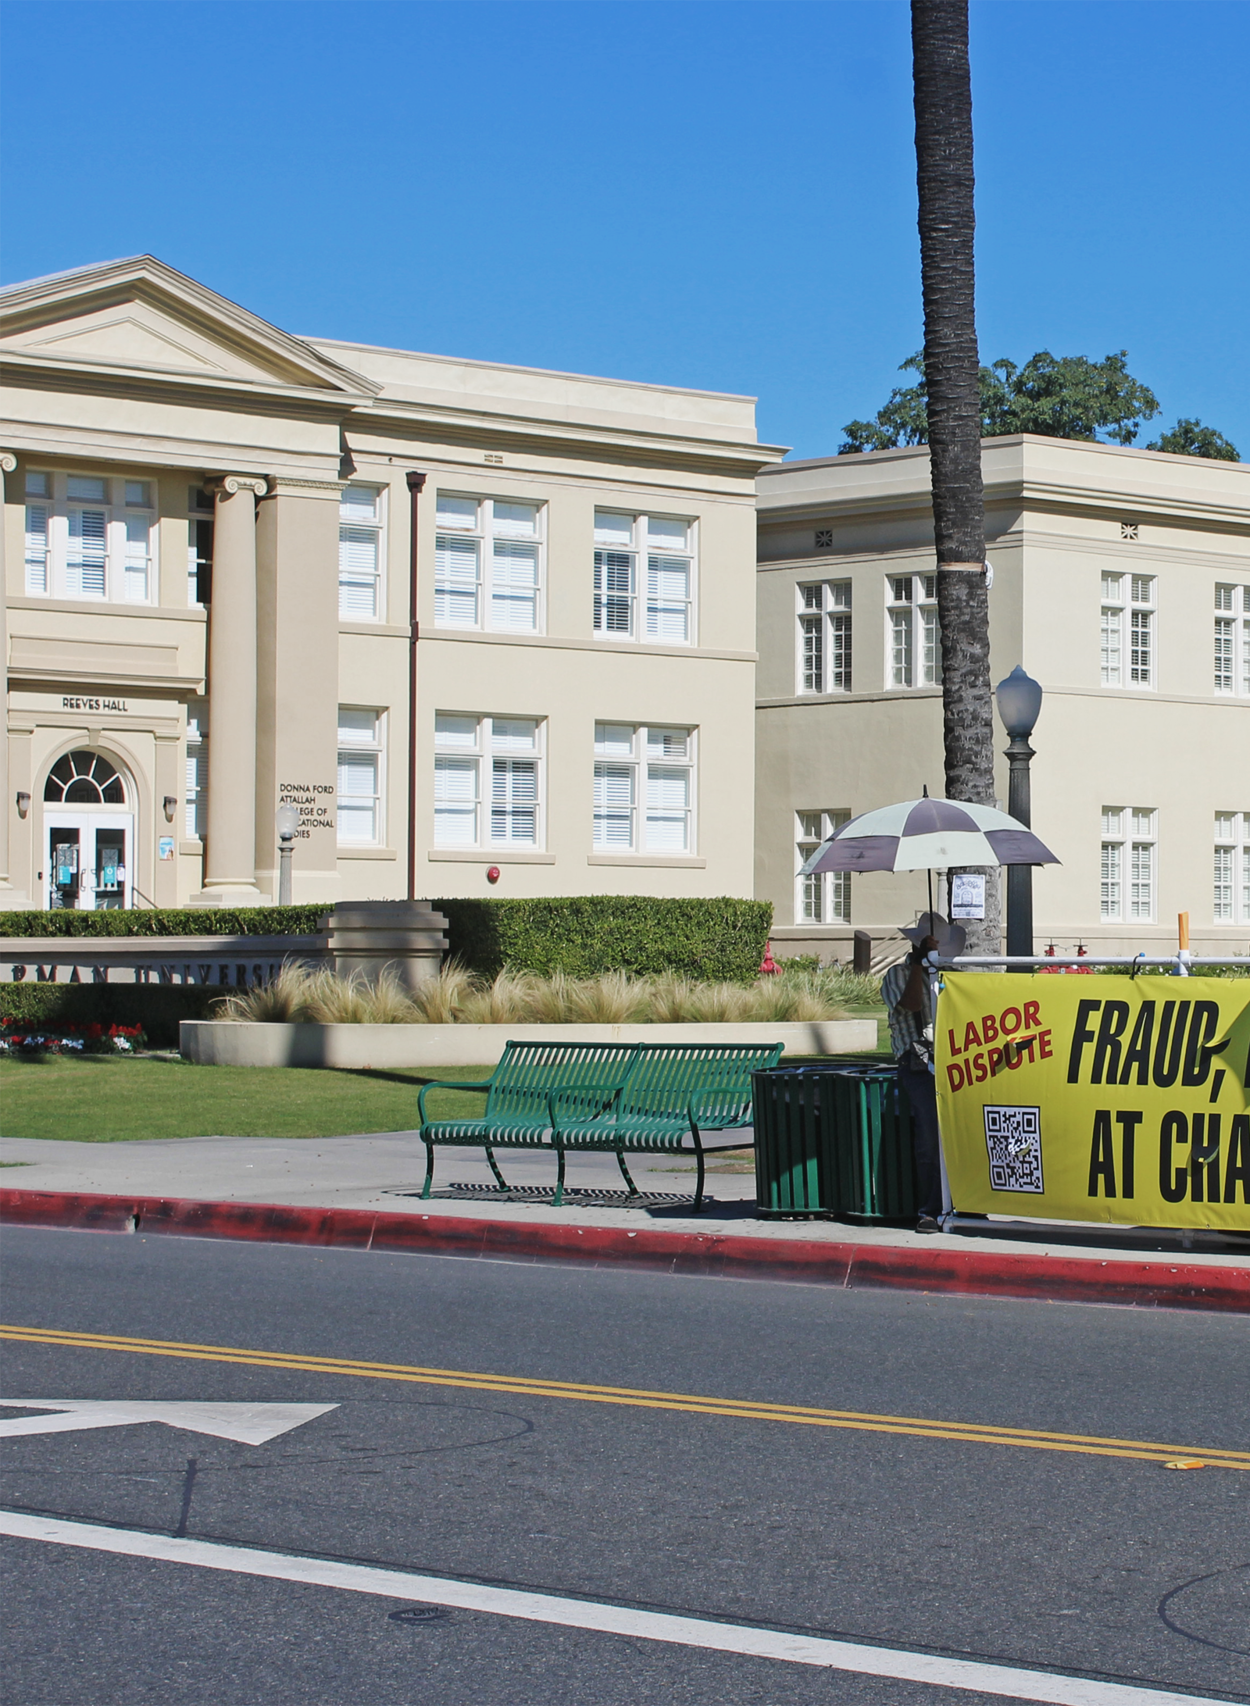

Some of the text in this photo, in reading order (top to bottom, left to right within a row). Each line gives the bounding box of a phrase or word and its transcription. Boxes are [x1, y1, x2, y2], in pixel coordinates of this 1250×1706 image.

[63, 697, 128, 712] REEVES HALL
[280, 783, 334, 794] DONNA FORD
[279, 795, 316, 805] ATTALLAH
[316, 807, 328, 817] OF
[294, 829, 311, 839] DIES
[134, 963, 285, 988] UNIVERSI
[948, 1000, 1042, 1057] LABOR
[946, 1029, 1054, 1093] DISPUTE
[1067, 999, 1227, 1103] FRAUD,
[1088, 1109, 1143, 1199] AT
